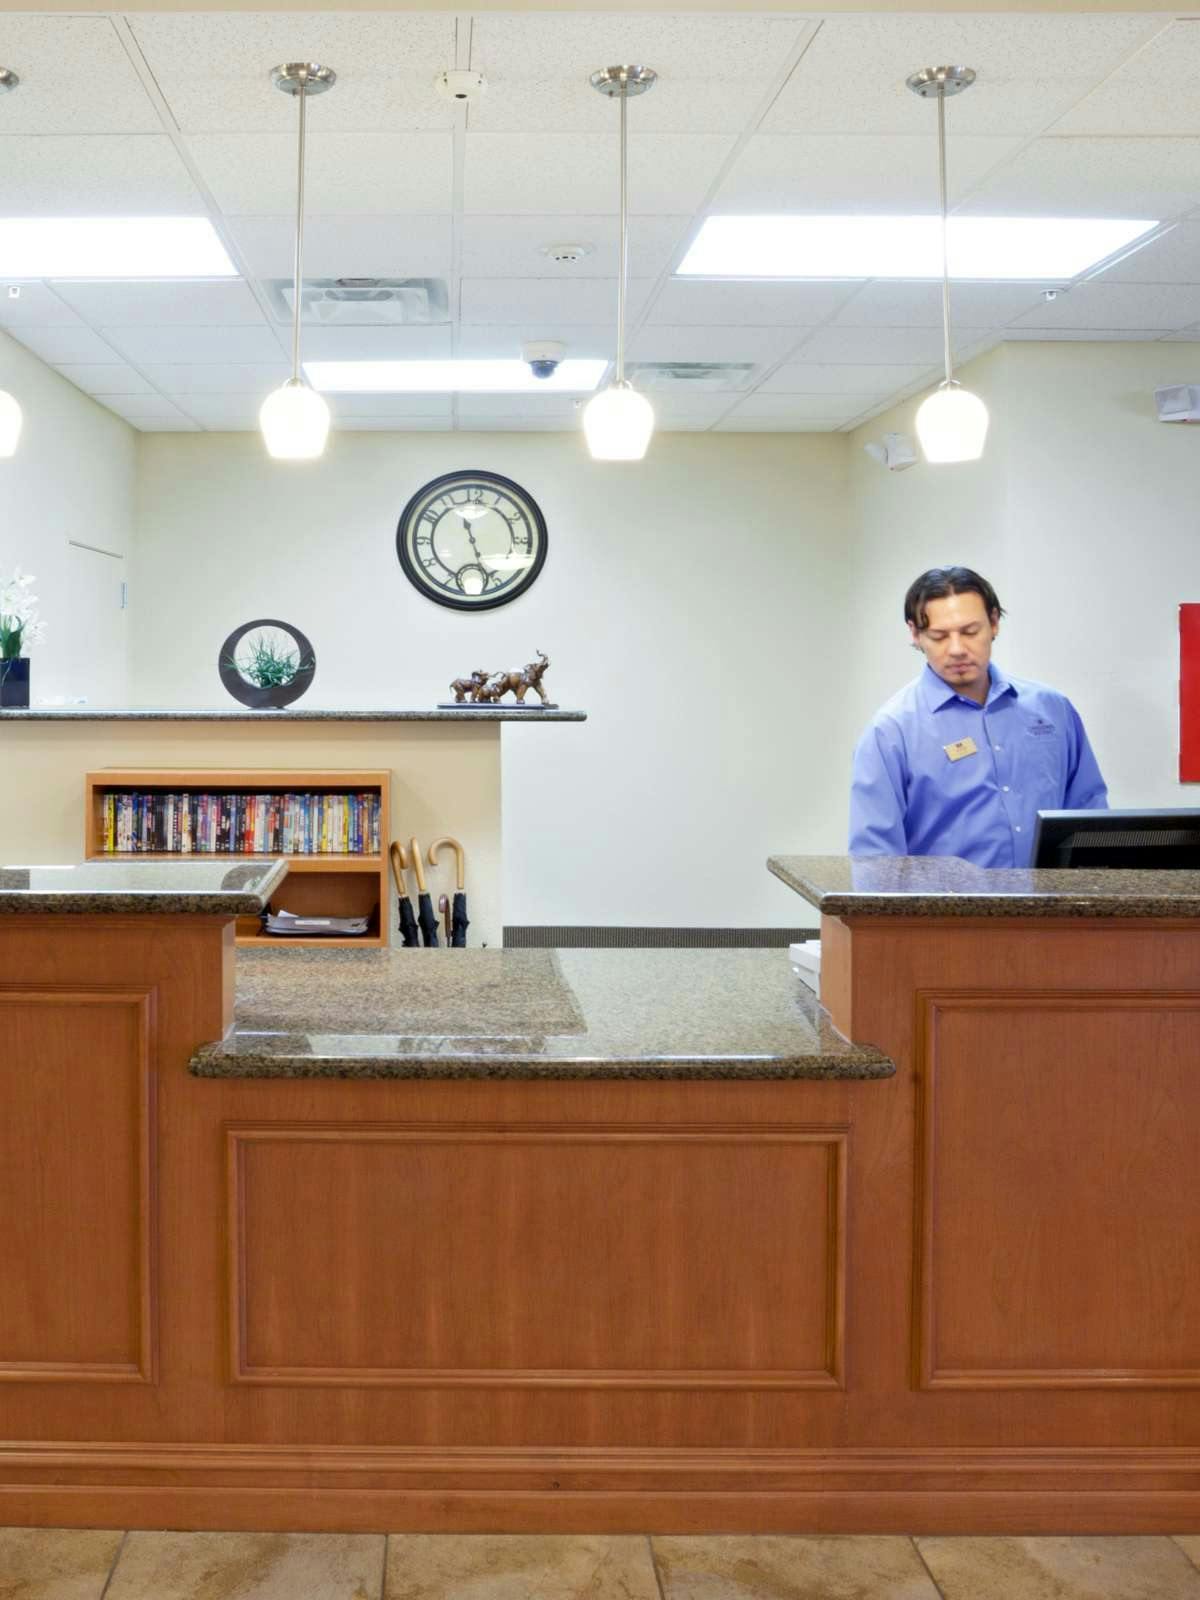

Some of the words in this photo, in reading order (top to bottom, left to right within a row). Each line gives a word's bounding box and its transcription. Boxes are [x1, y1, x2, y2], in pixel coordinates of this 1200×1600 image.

[467, 489, 484, 503] 12
[508, 511, 521, 525] 2
[416, 536, 431, 546] 9
[514, 536, 528, 545] 3
[423, 558, 436, 568] 8
